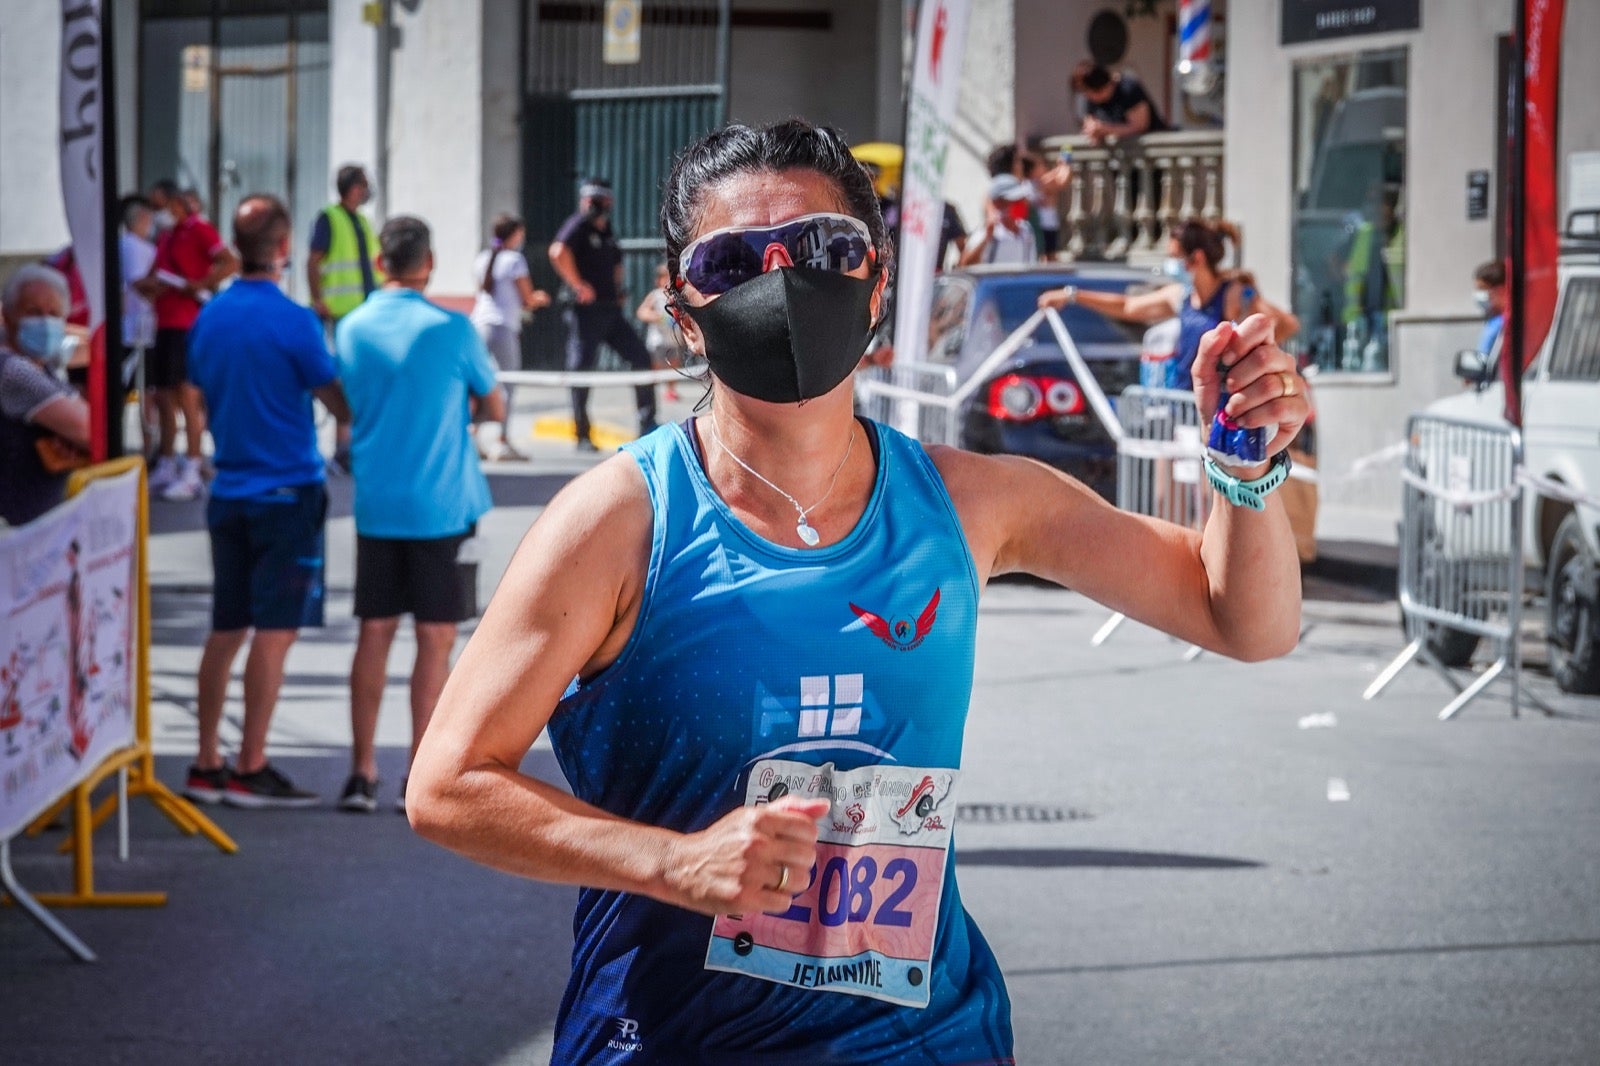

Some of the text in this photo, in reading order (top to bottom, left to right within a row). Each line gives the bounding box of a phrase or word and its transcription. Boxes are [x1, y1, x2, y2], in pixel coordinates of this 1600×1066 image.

[808, 774, 847, 801] PRIO
[853, 781, 872, 799] DE
[788, 959, 882, 988] JEANNINE
